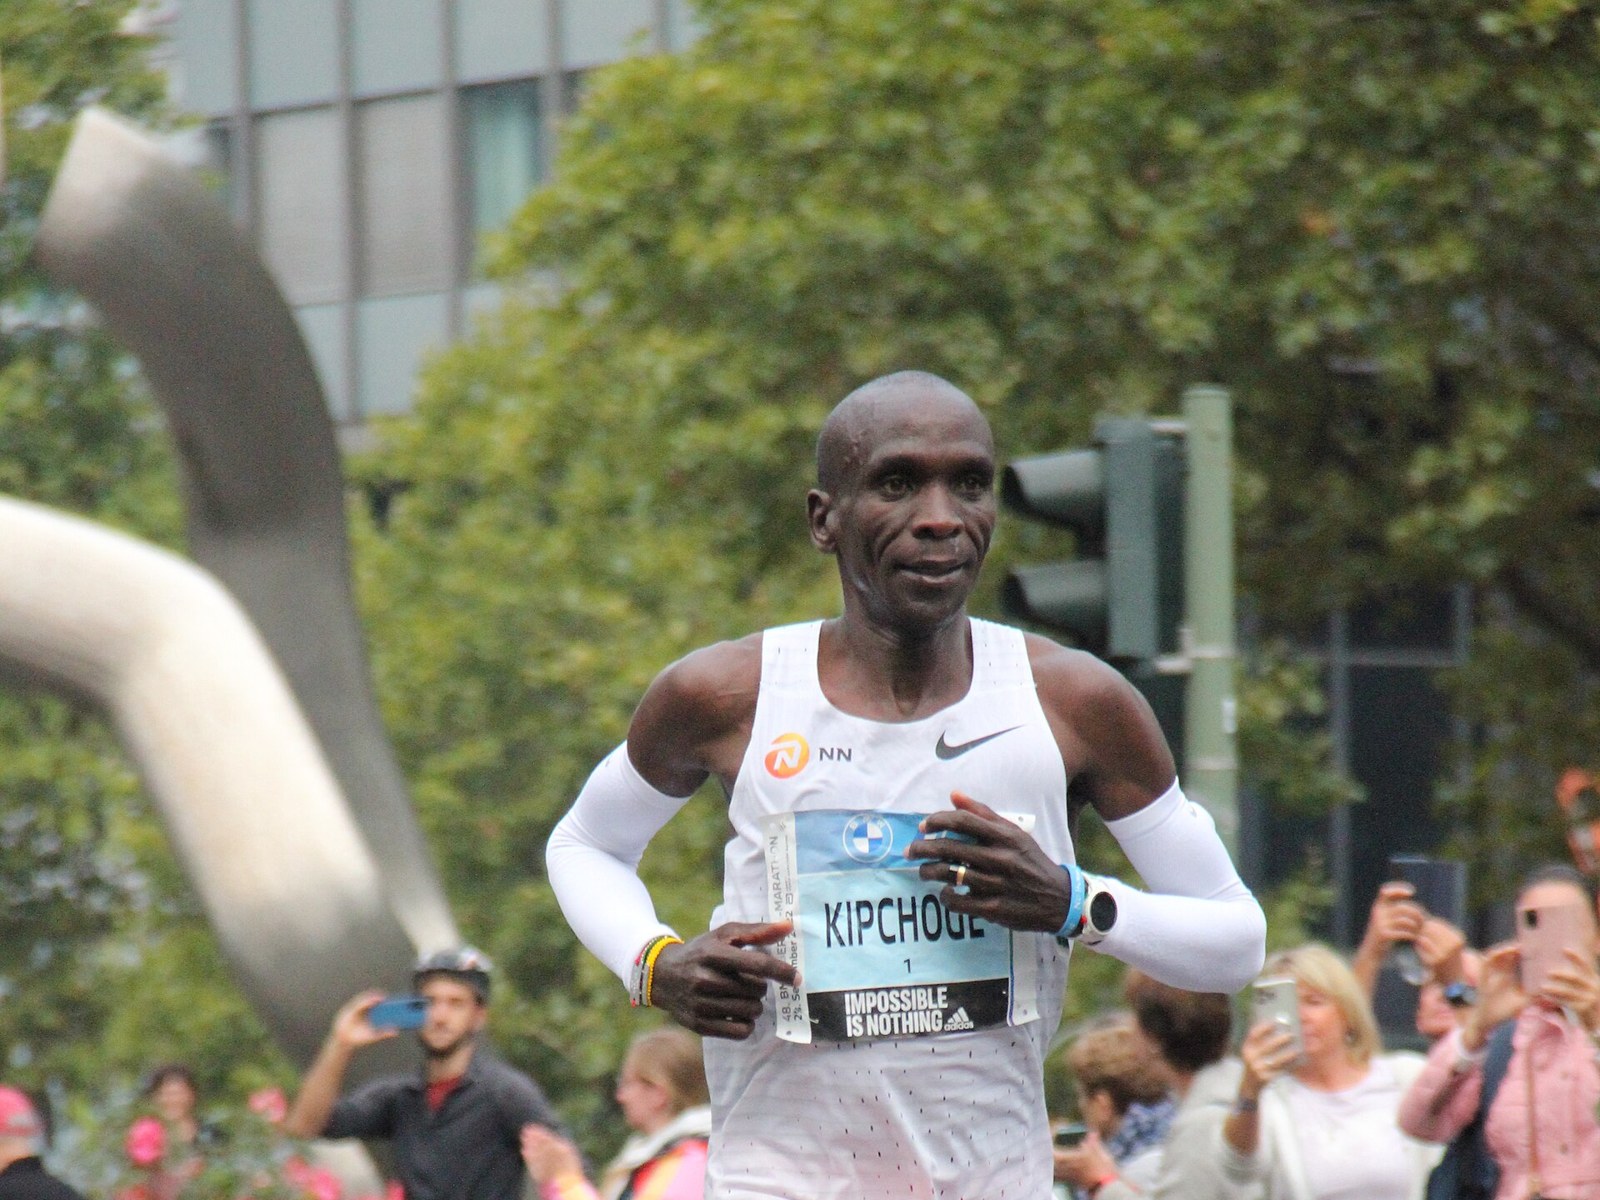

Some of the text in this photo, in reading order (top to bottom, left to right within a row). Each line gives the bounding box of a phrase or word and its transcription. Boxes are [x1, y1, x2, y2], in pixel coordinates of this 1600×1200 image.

[819, 746, 852, 763] NN
[789, 941, 801, 1002] Sember
[903, 958, 911, 974] 1
[844, 986, 949, 1016] IMPOSSIBLE
[846, 1009, 943, 1038] IS NOTHING
[944, 1020, 974, 1032] adidas
